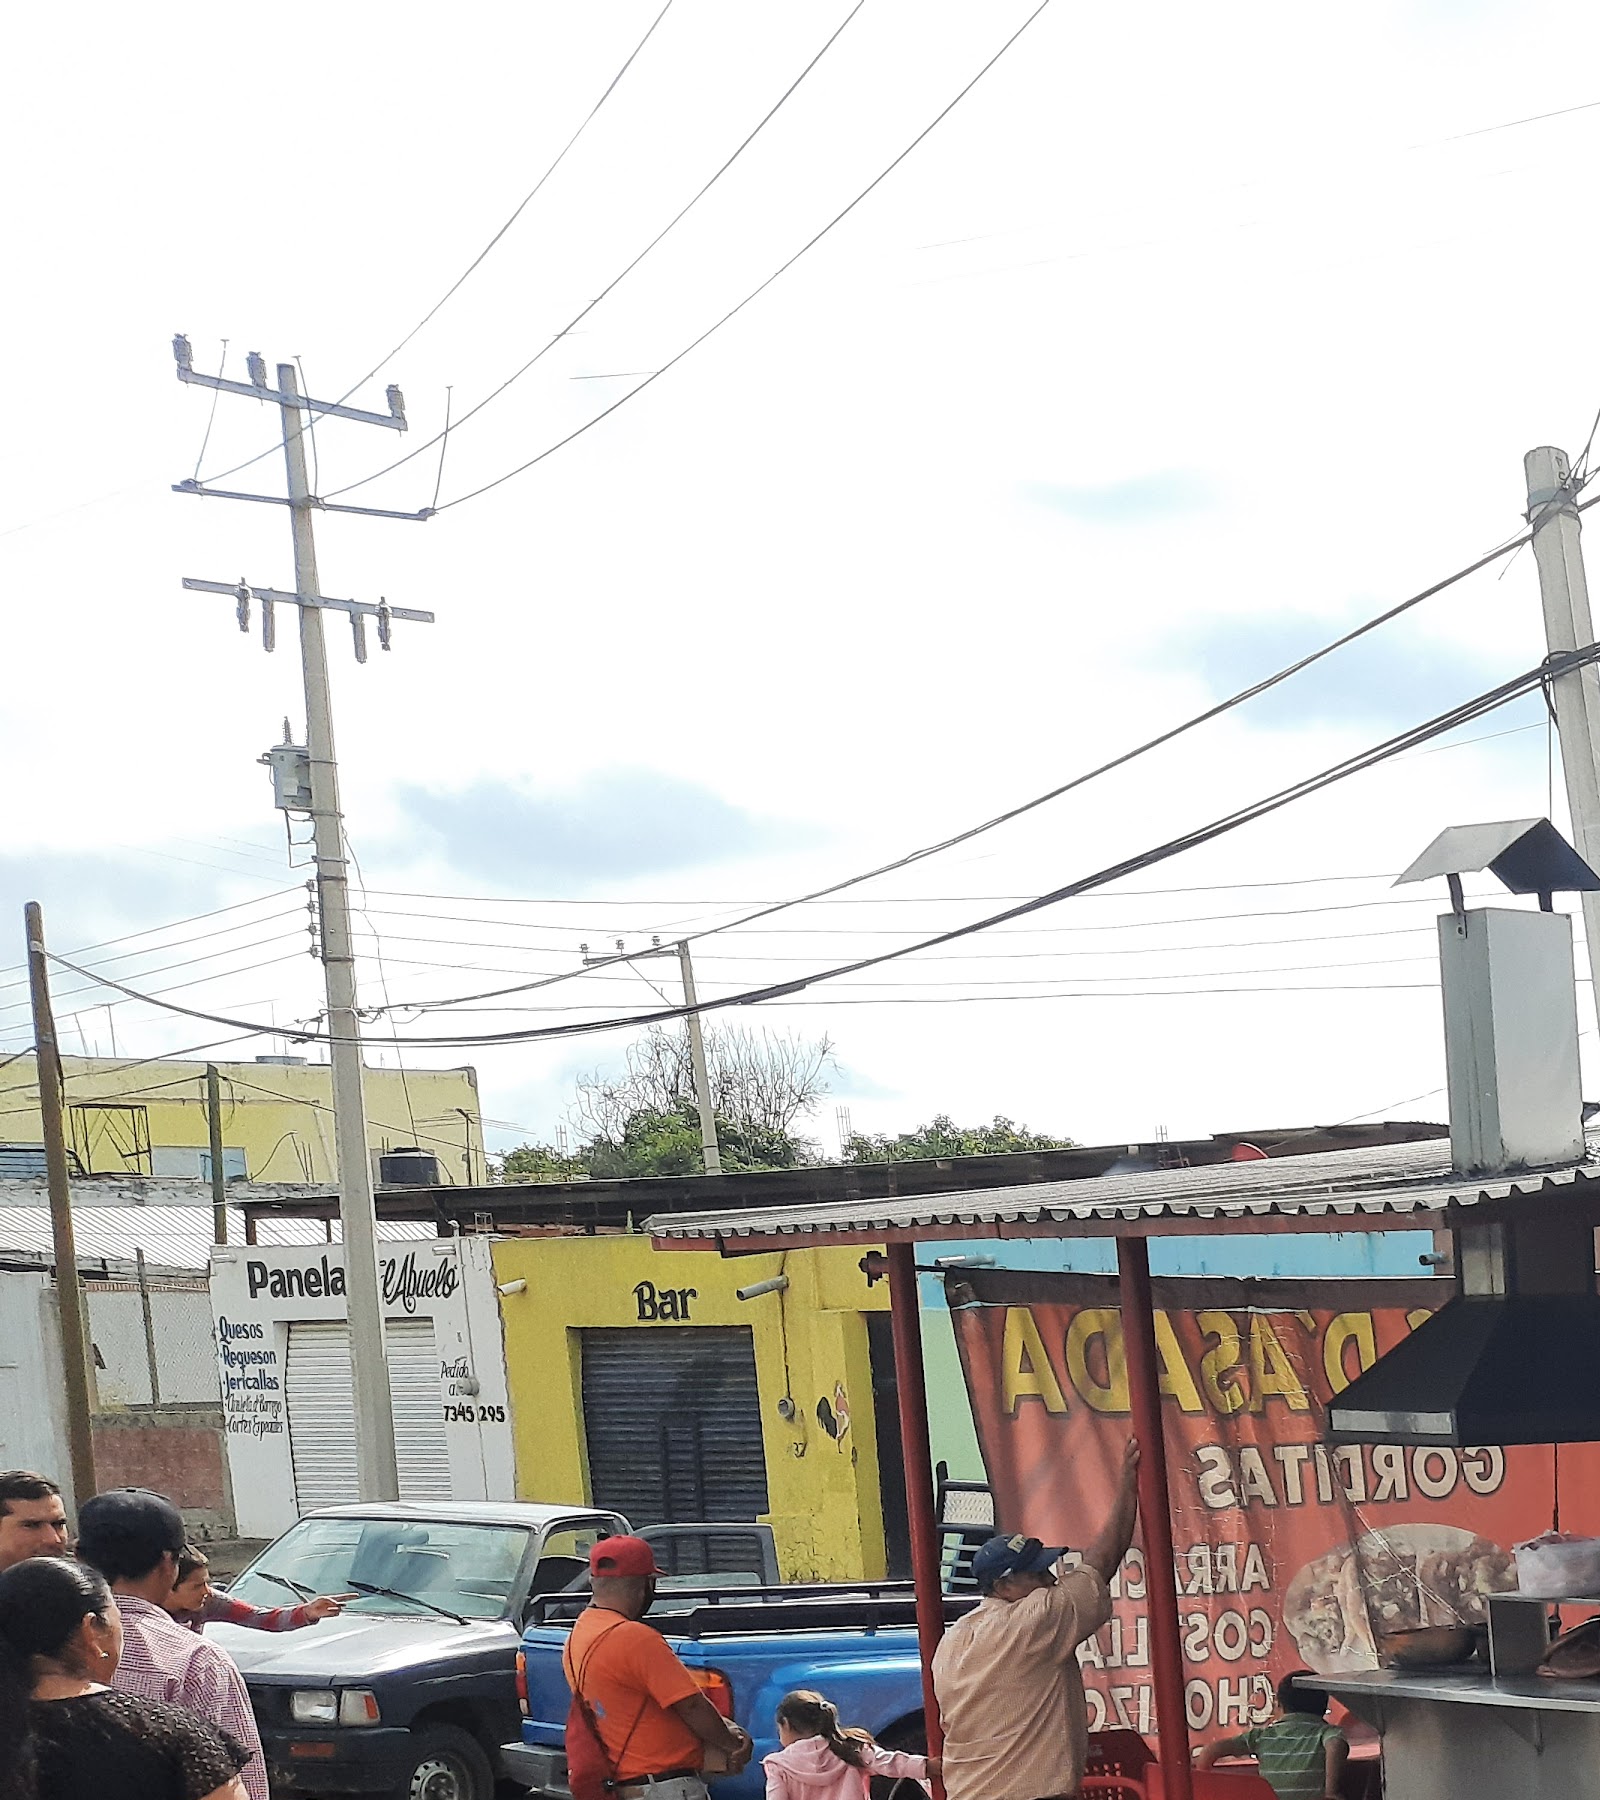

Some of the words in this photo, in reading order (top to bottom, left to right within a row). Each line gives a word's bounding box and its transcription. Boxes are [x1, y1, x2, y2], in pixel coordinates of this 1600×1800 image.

[634, 1281, 698, 1321] Bar
[219, 1316, 264, 1344] Quesos
[222, 1344, 277, 1370] Requeson
[224, 1368, 280, 1399] Jericallas
[443, 1402, 475, 1423] 7345
[479, 1404, 505, 1423] 295
